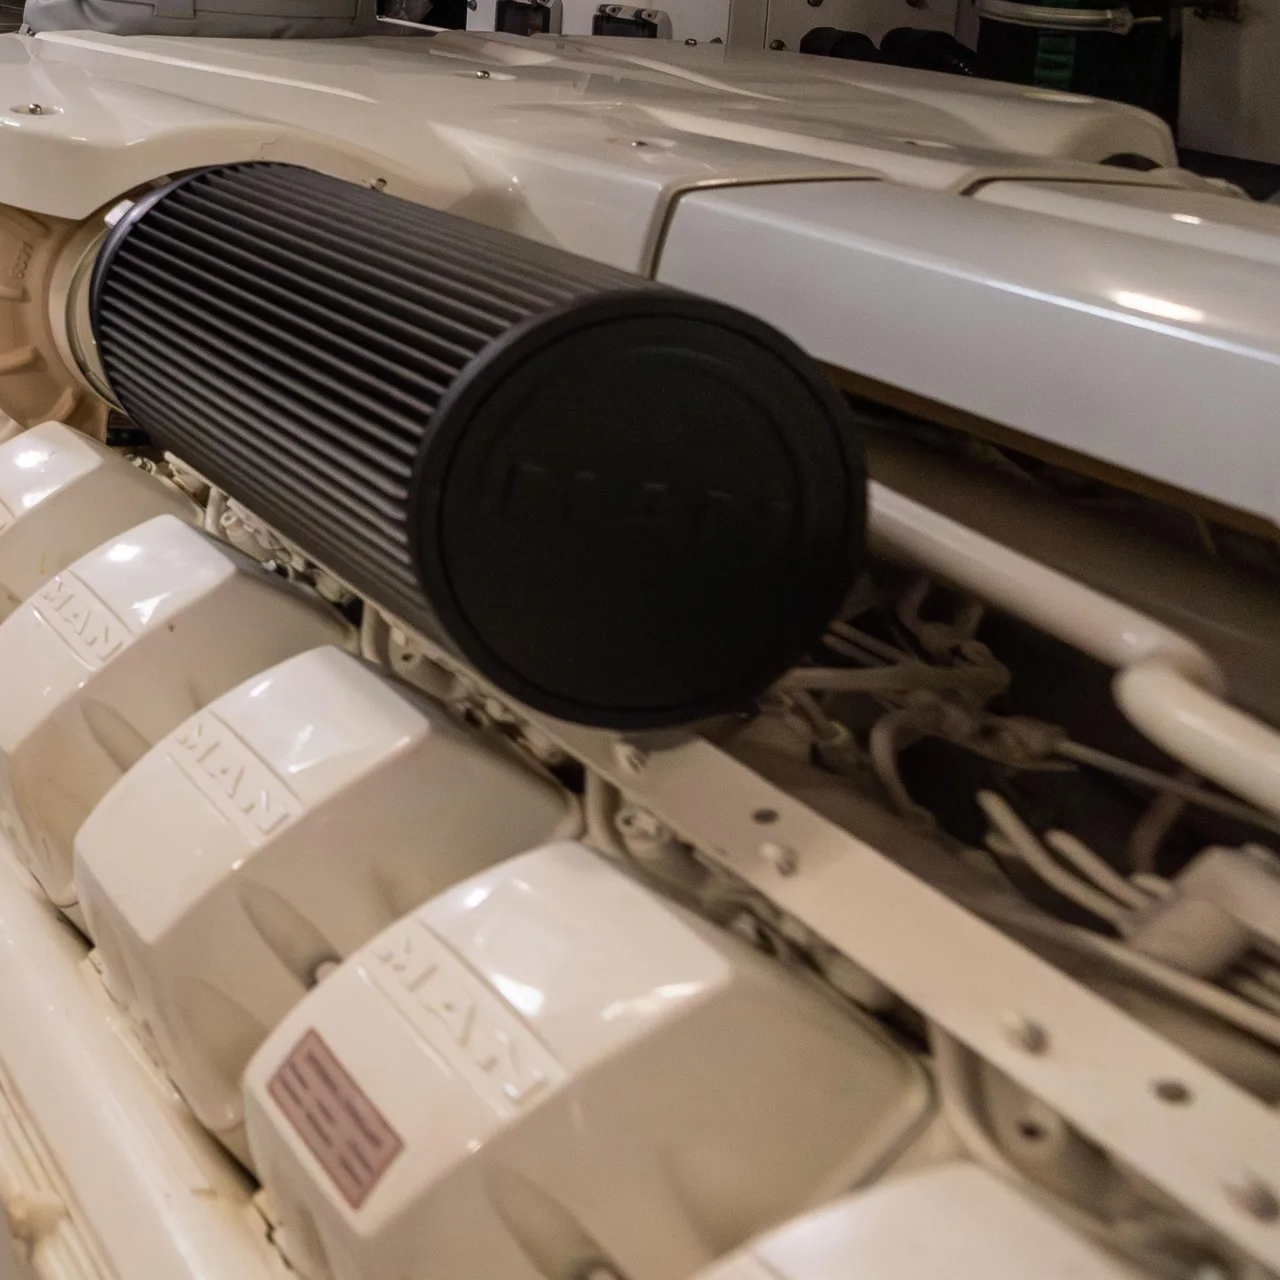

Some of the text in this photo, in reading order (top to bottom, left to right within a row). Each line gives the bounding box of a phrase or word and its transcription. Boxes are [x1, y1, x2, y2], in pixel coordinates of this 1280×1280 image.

[41, 576, 128, 661] MAN
[174, 722, 290, 833] MAN
[373, 933, 551, 1106] MAN
